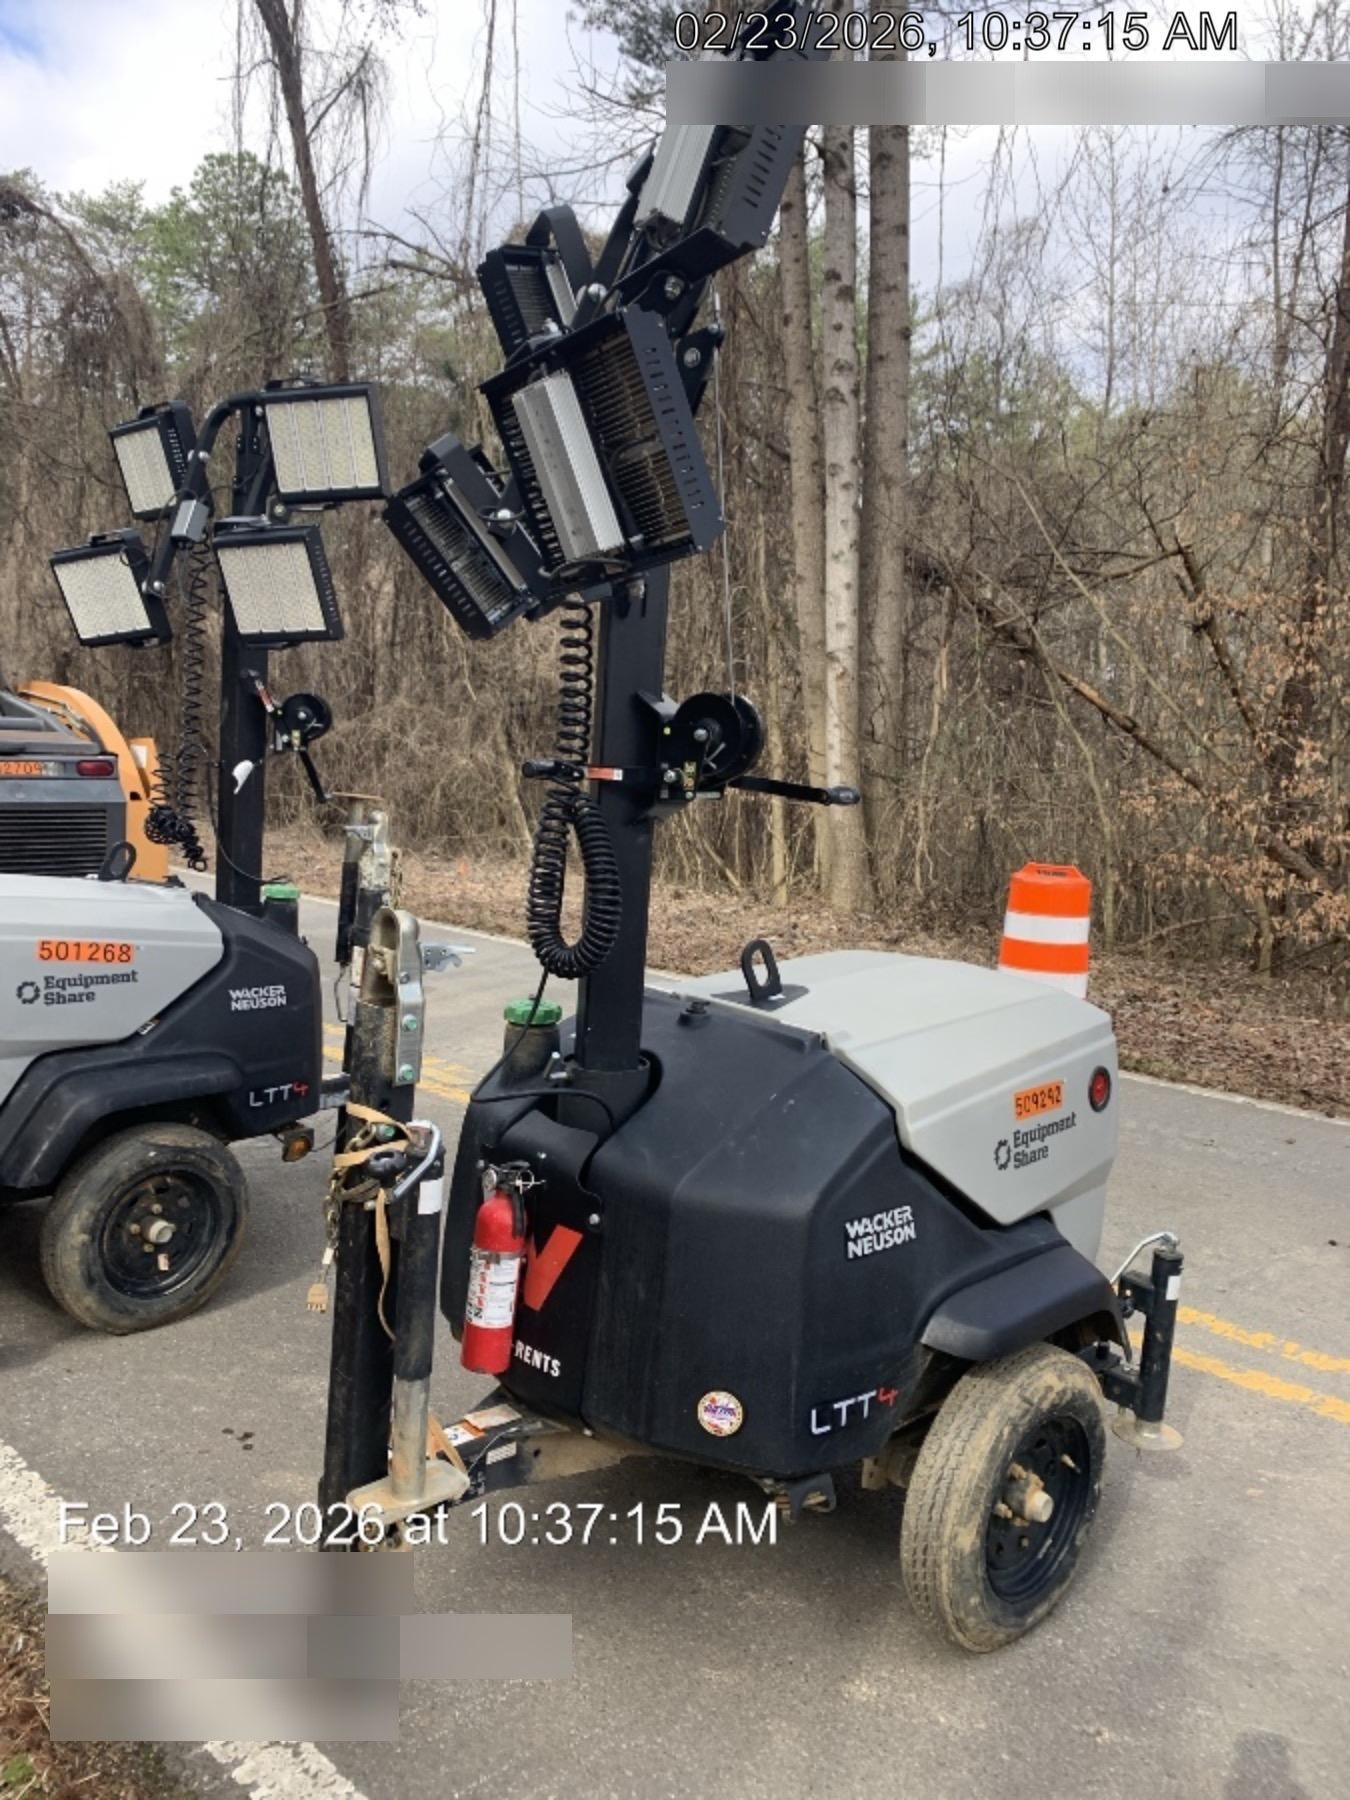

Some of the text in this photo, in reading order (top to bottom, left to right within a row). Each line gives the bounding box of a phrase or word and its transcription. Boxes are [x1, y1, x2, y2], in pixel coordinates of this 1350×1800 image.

[39, 941, 132, 963] 501268
[43, 969, 138, 990] Equipment
[43, 991, 96, 1006] Share
[228, 985, 286, 1000] WACKER
[231, 996, 287, 1011] NEUSON
[1013, 1111, 1077, 1149] Equipment
[1013, 1144, 1050, 1170] Share
[845, 1204, 914, 1239] WACKER
[847, 1223, 917, 1260] NEUSON
[514, 1339, 561, 1377] RENTS
